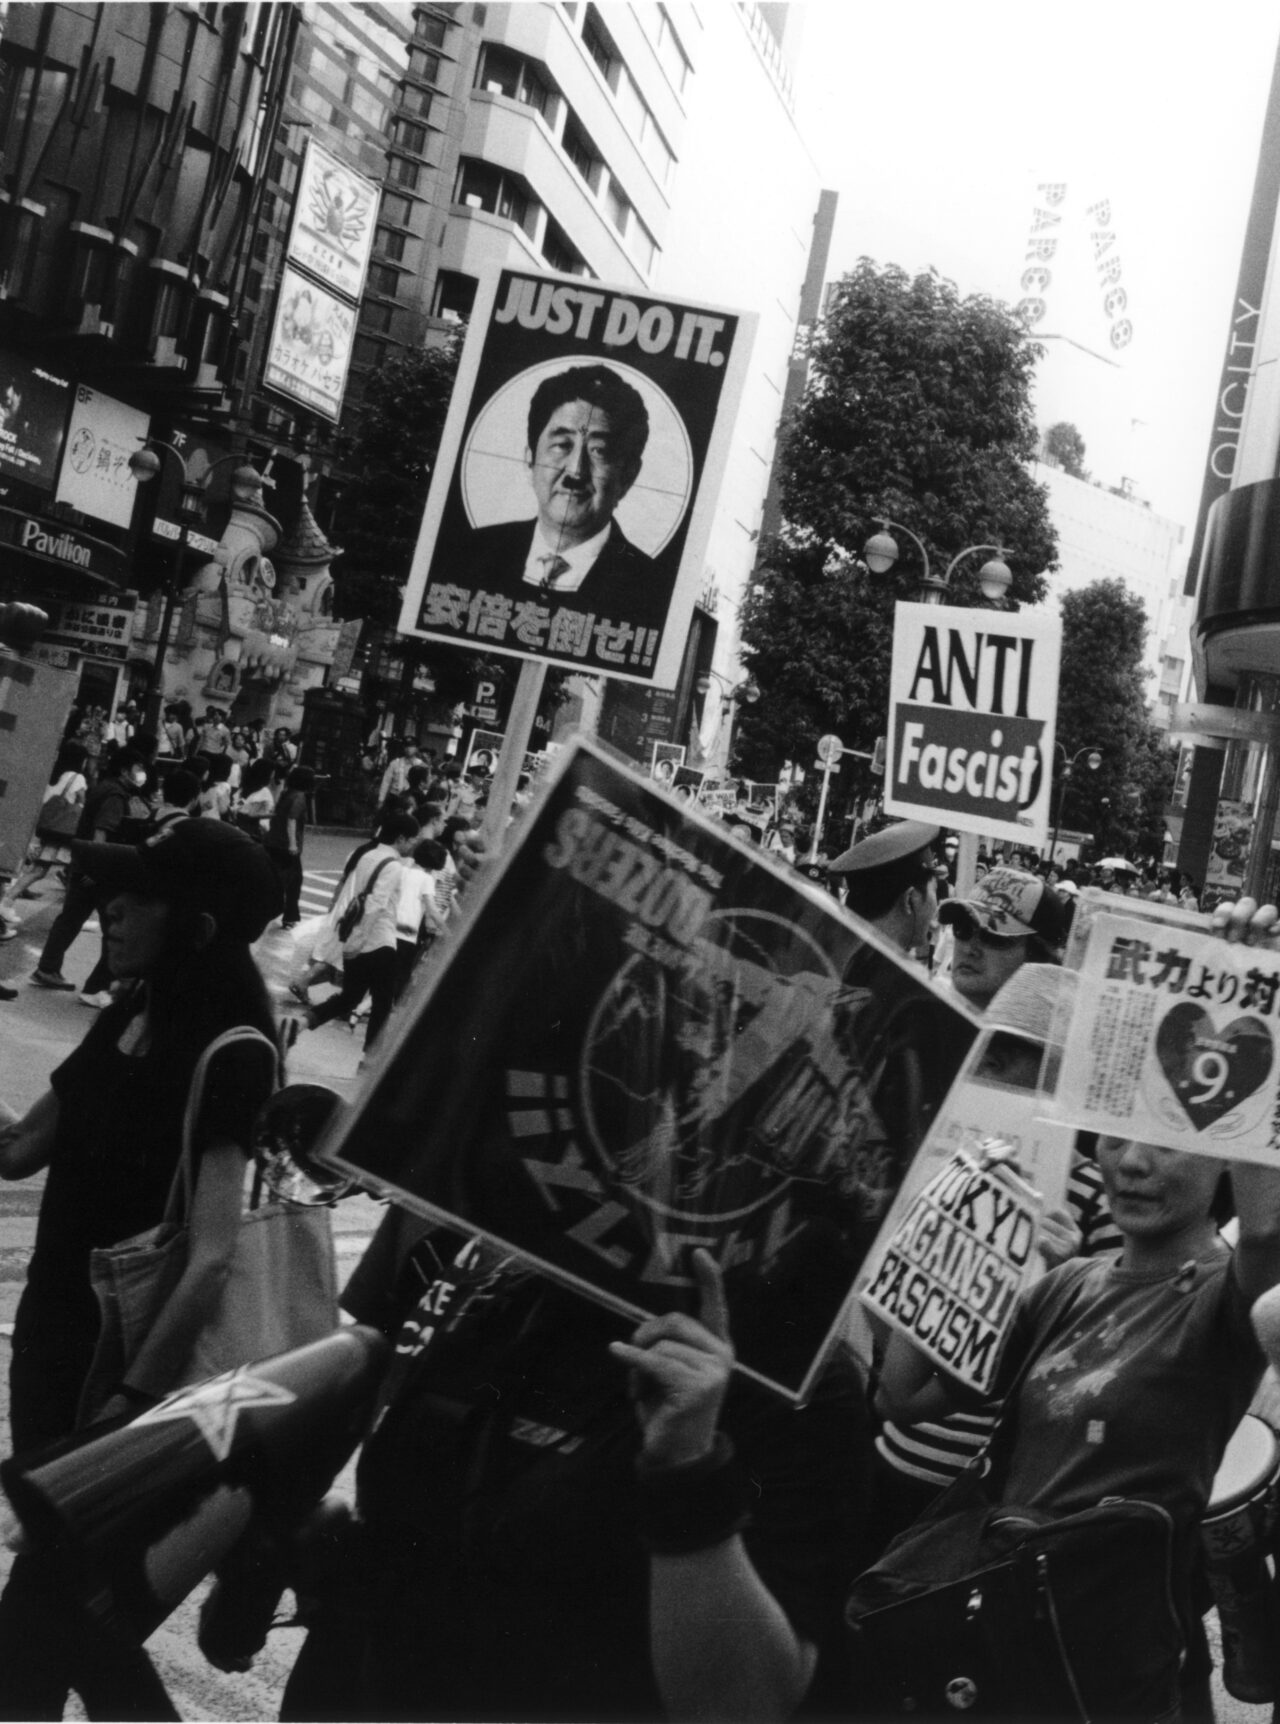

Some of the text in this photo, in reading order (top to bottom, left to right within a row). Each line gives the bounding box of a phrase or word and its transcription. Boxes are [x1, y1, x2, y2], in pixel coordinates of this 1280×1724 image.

[1017, 182, 1067, 323] PARCO
[1085, 198, 1133, 350] PARCO
[496, 276, 726, 368] JUST DO IT.
[78, 386, 94, 404] 8F
[172, 429, 187, 448] 7F
[22, 519, 92, 568] Pavilion
[476, 682, 495, 703] P
[908, 625, 1035, 718] ANTI
[897, 721, 1039, 806] Fascist
[1189, 1051, 1229, 1104] 9
[867, 1249, 998, 1383] FASCISM
